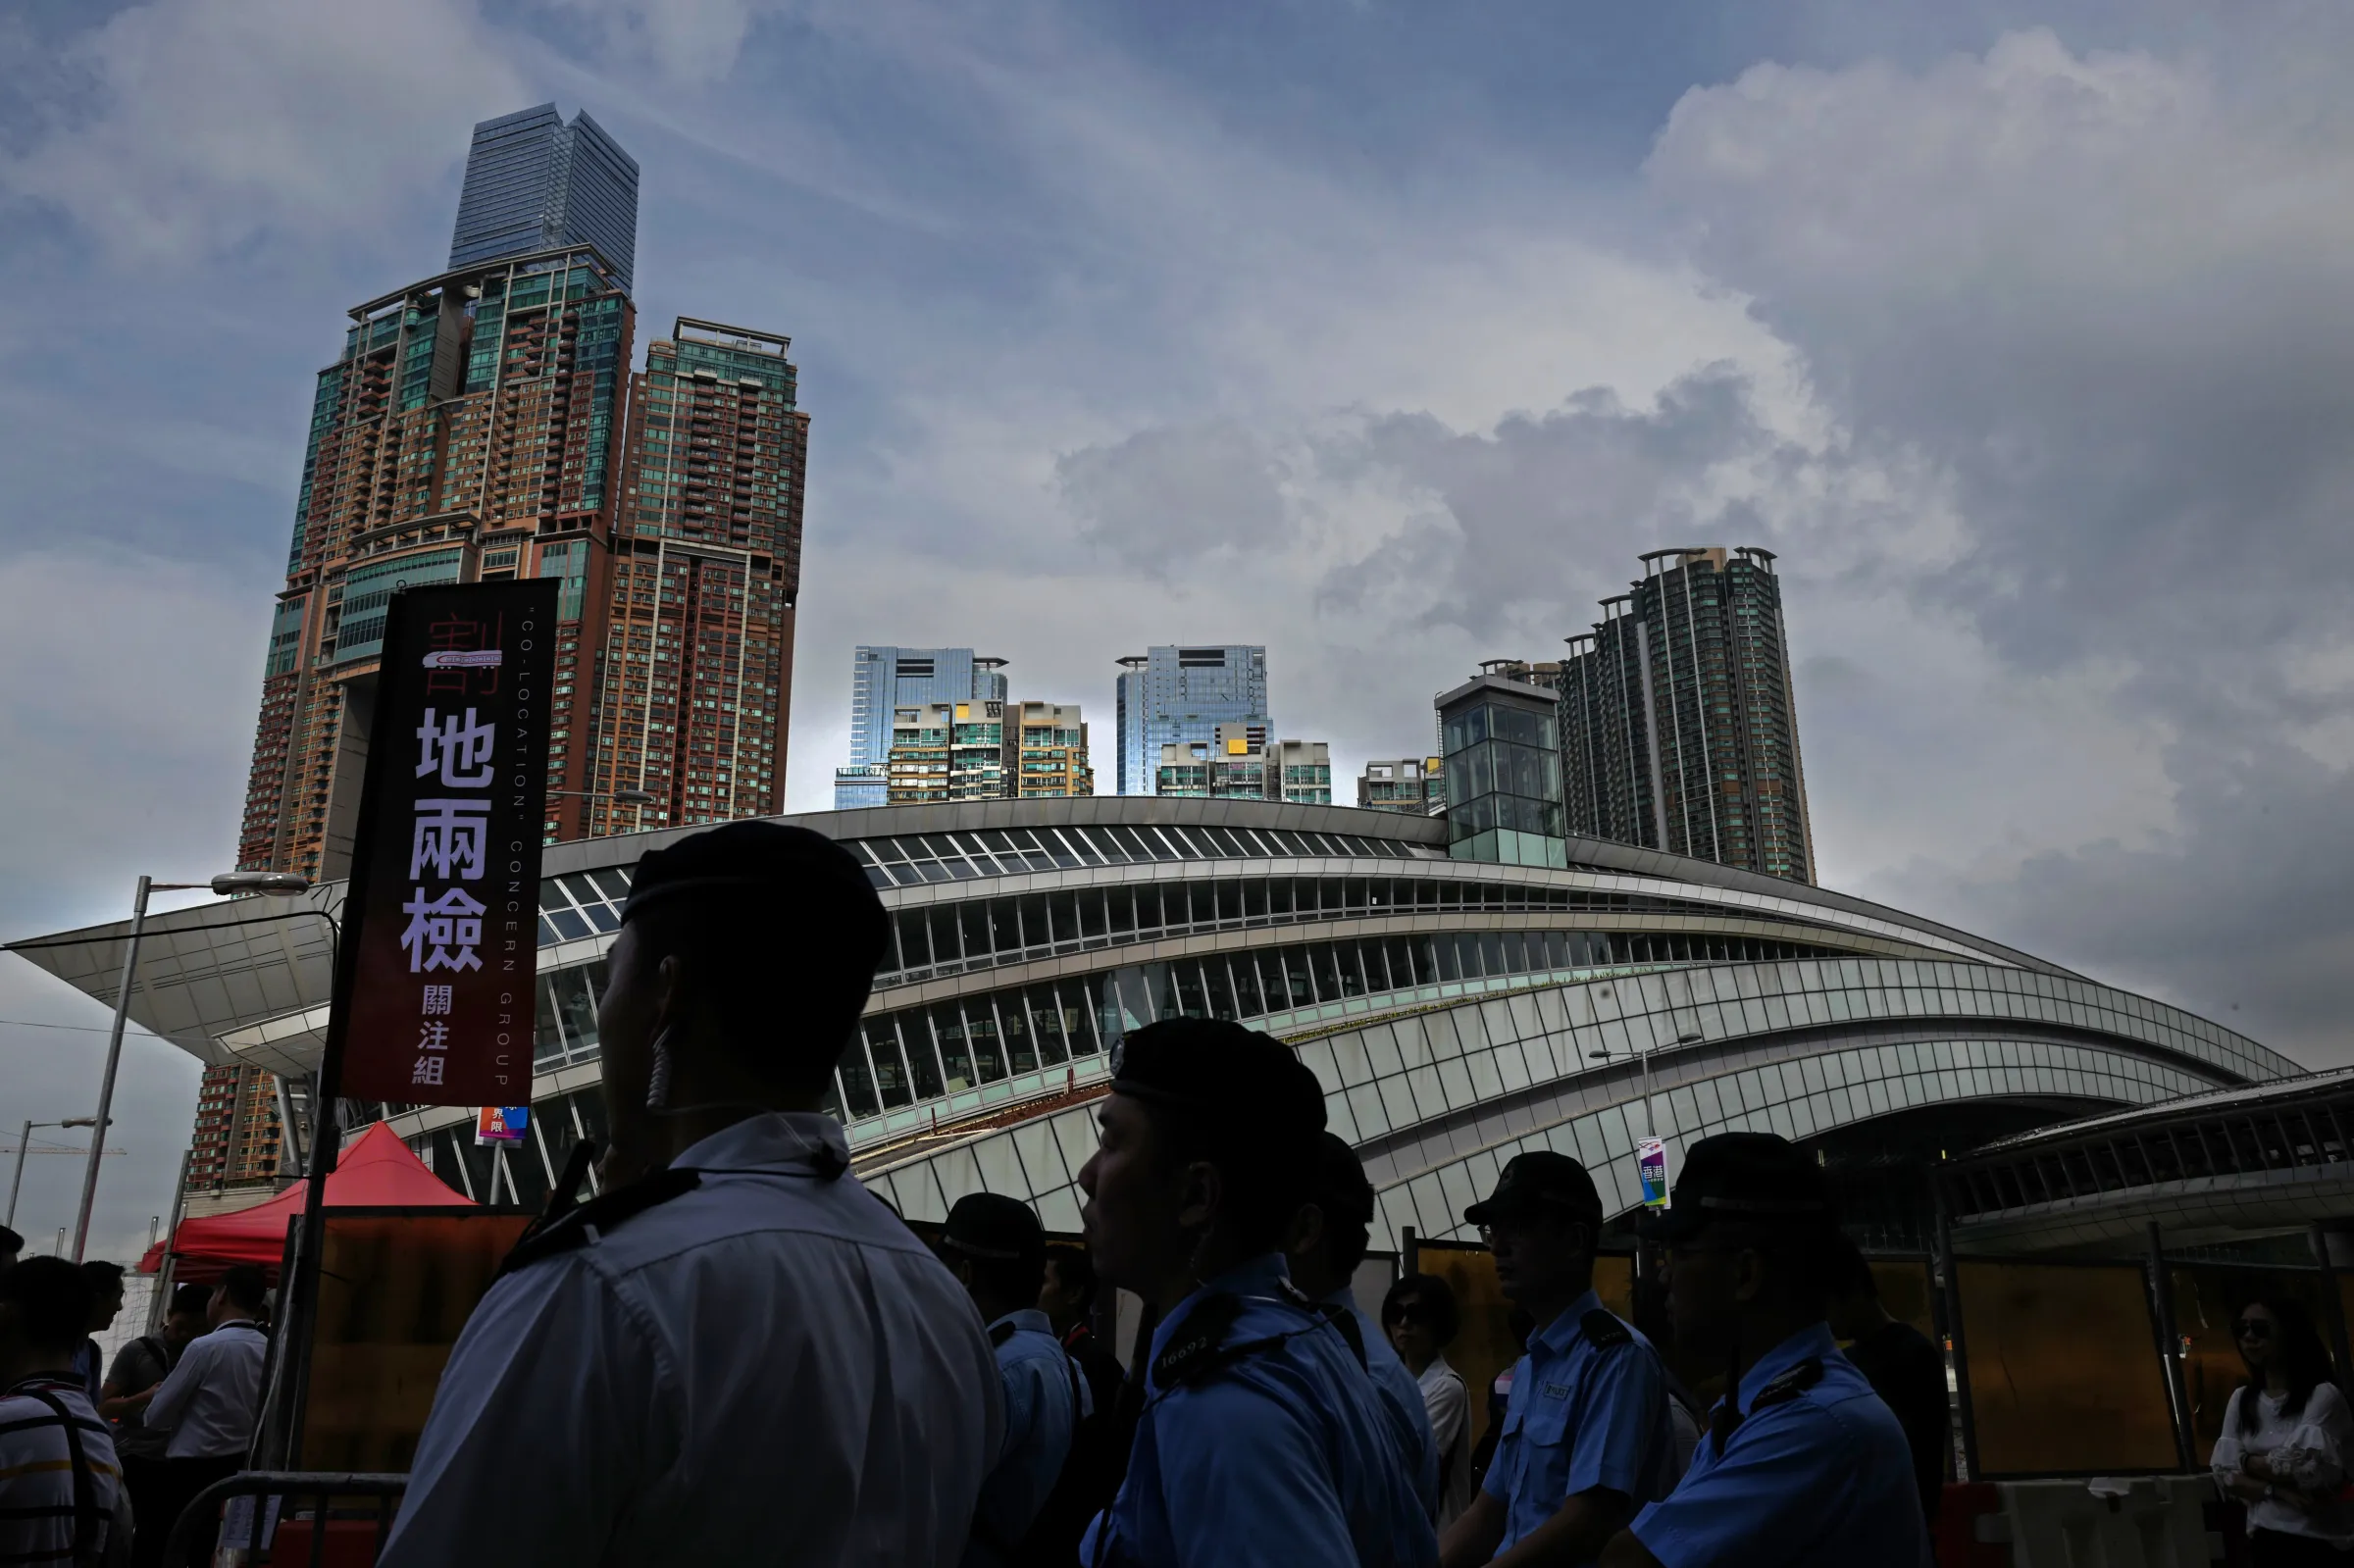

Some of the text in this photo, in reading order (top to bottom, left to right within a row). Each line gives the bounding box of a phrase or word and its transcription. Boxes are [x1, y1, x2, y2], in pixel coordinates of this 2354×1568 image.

[503, 840, 523, 972] CONCERN
[412, 984, 453, 1087] 關注組
[495, 992, 511, 1087] GROUP
[1642, 1165, 1663, 1178] 香港
